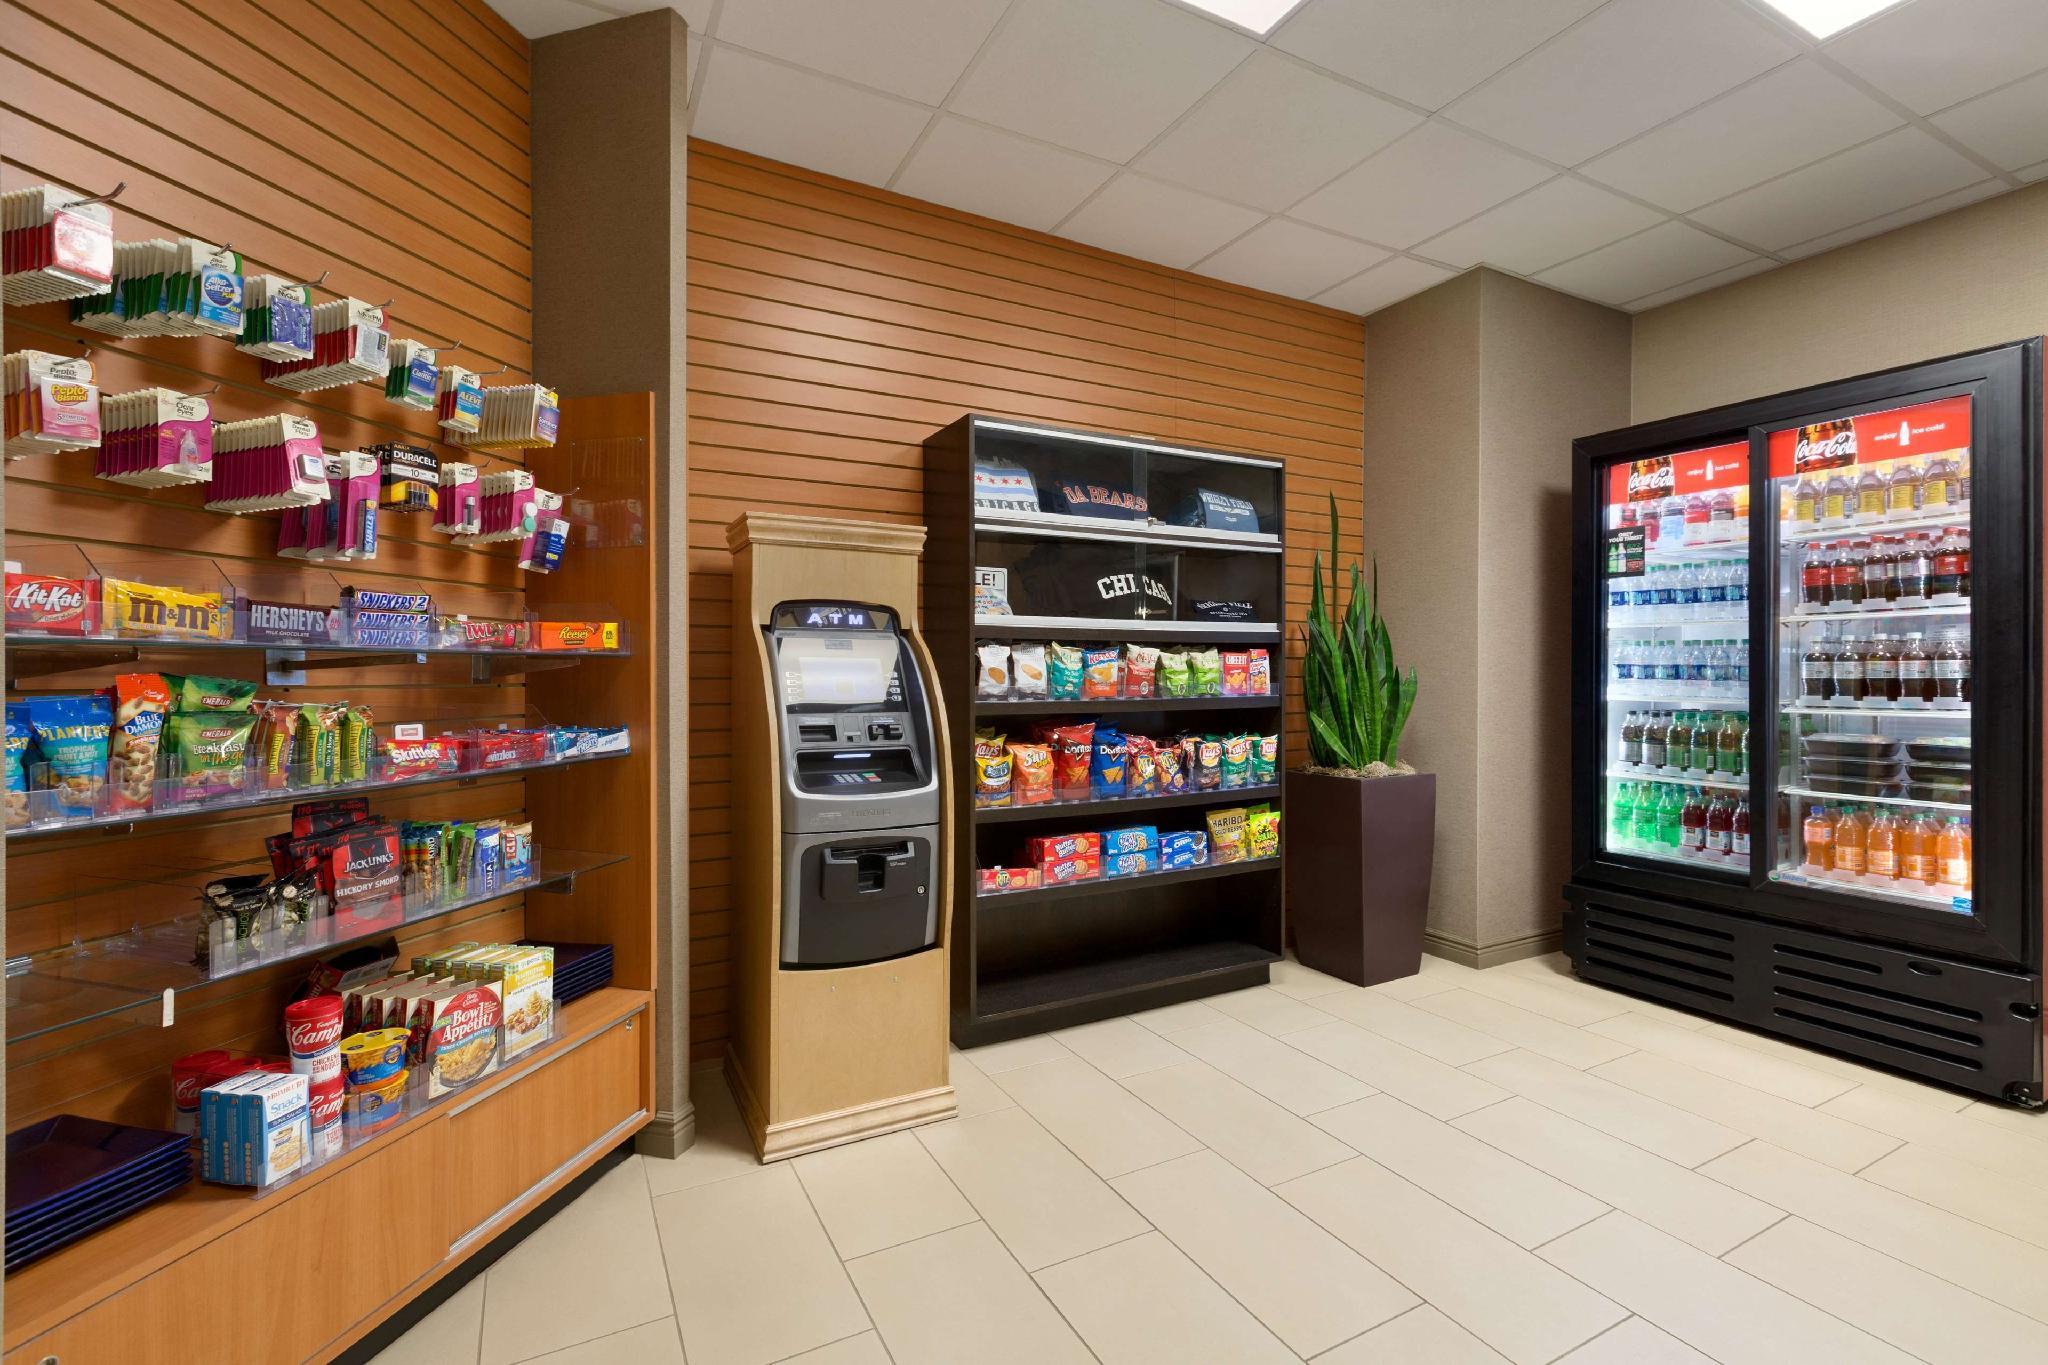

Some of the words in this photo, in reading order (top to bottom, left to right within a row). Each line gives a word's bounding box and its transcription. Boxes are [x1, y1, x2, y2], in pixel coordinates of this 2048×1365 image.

[51, 384, 89, 397] Pepto-
[57, 394, 87, 402] Bismol
[1912, 427, 1925, 435] ice
[1925, 423, 1946, 432] cold
[1796, 431, 1858, 464] Coca-Cola
[393, 450, 438, 468] DURACELL
[1629, 466, 1675, 492] Coca-Cola
[1063, 485, 1090, 504] DA
[1087, 485, 1148, 512] BEARS
[366, 513, 374, 543] HALLS
[360, 591, 415, 611] SNICKERS
[416, 596, 428, 608] 2
[250, 604, 326, 632] HERSHEY'S
[357, 612, 415, 629] SNICKERS
[807, 612, 864, 626] ATM
[279, 630, 310, 638] CHOCOLATE
[358, 629, 414, 647] SNICKERS
[202, 696, 232, 706] EMERALD
[134, 712, 160, 725] BLUE
[37, 724, 111, 743] PLANTERS
[202, 728, 232, 738] EMERALD
[58, 744, 96, 755] TROPICAL
[193, 743, 246, 755] Breakfast
[392, 746, 440, 764] Skittles
[1064, 744, 1092, 755] Doritos
[1100, 745, 1128, 756] Doritos
[1201, 746, 1222, 760] Lay's
[1213, 816, 1243, 828] HARIBO
[1054, 839, 1075, 852] Nutter
[1174, 836, 1192, 849] OREO
[344, 859, 369, 873] JACK
[336, 882, 374, 898] HICKORY
[452, 1002, 485, 1027] Bowl
[270, 1093, 303, 1114] Snack
